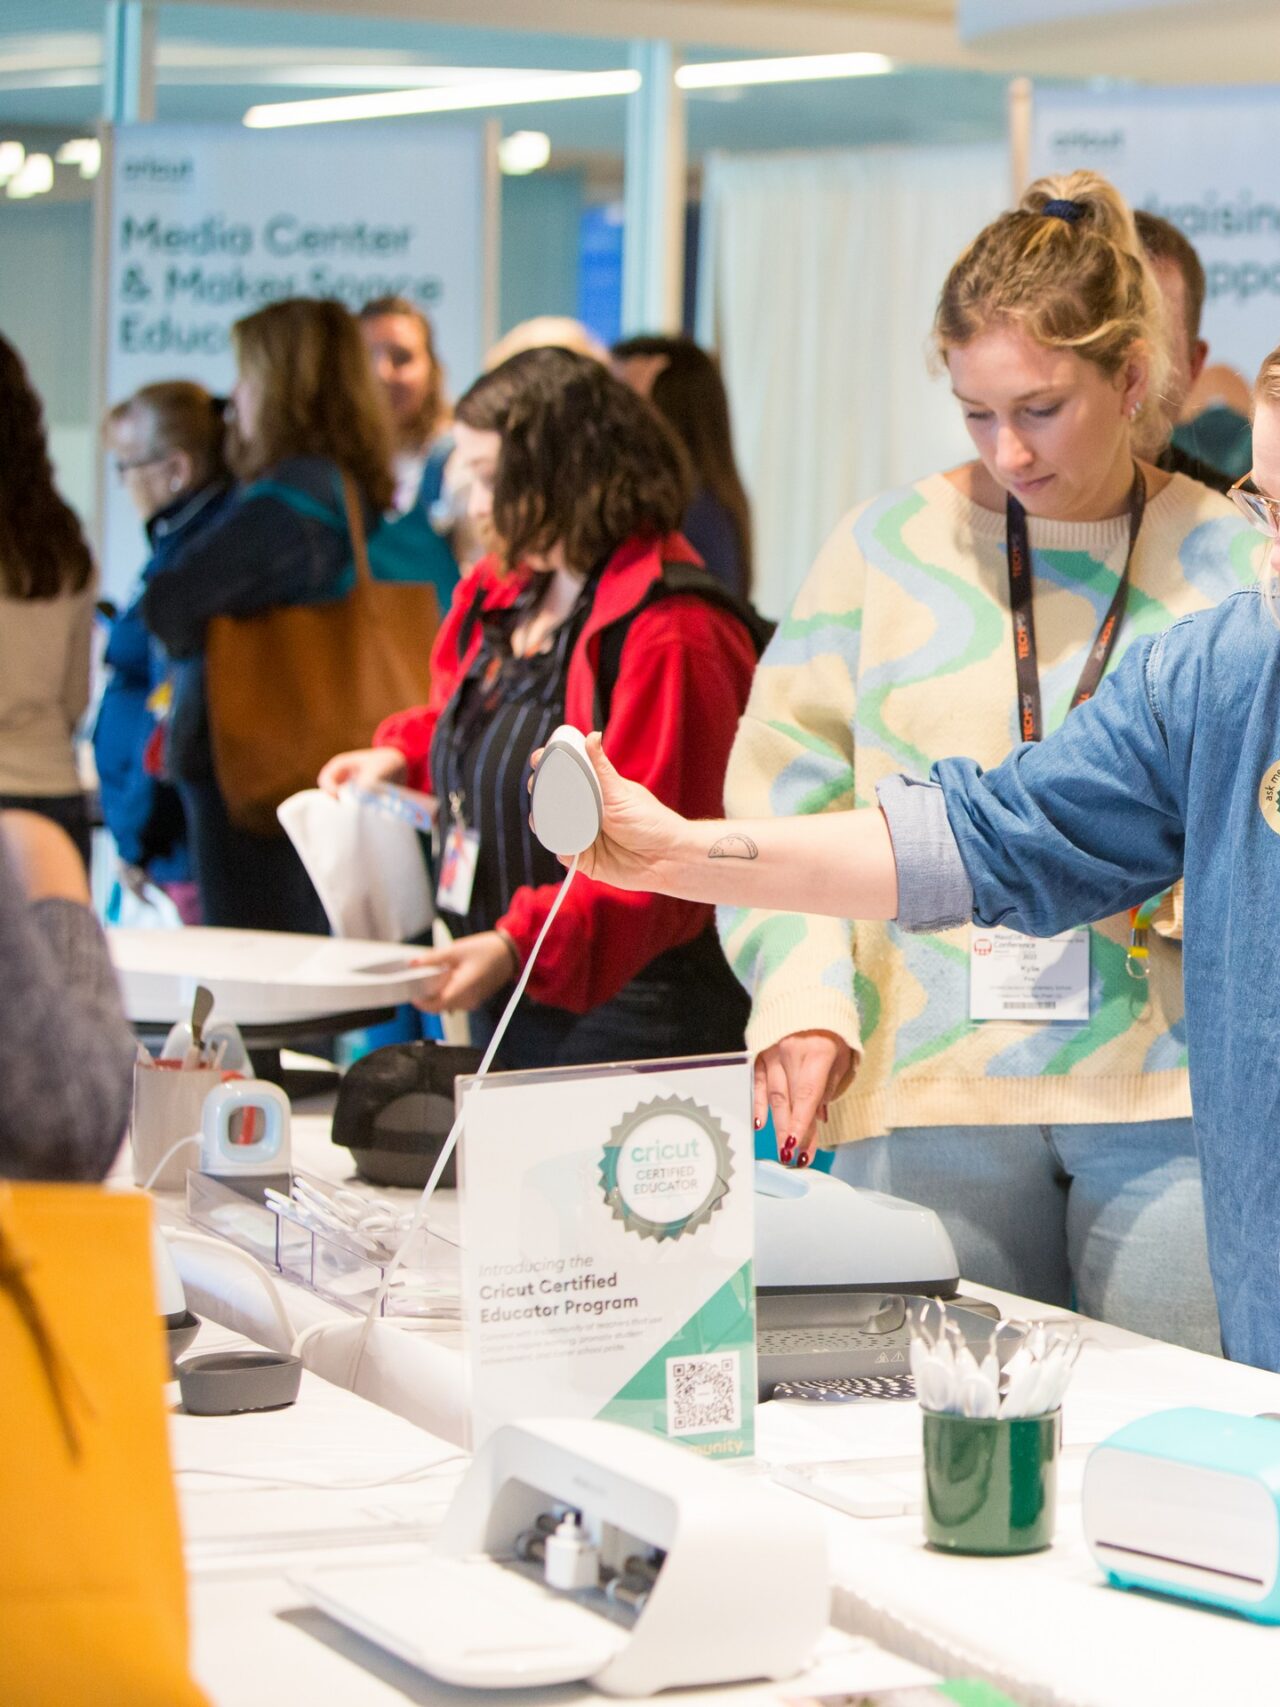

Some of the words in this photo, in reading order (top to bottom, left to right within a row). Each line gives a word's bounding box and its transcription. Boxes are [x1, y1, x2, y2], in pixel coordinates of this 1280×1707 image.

[122, 213, 252, 252] Media
[264, 213, 413, 255] Center
[121, 264, 150, 300] &
[164, 263, 295, 301] Maker
[119, 314, 233, 352] Educ
[1264, 785, 1276, 802] ask
[631, 1138, 700, 1163] cricut
[636, 1166, 695, 1181] CERTIFIED
[633, 1179, 698, 1195] EDUCATOR
[478, 1256, 566, 1277] Introducing
[570, 1254, 594, 1268] the
[480, 1283, 534, 1300] Cricut
[538, 1272, 617, 1294] Certified
[480, 1303, 560, 1324] Educator
[564, 1296, 639, 1316] Program
[692, 1437, 743, 1457] munity
